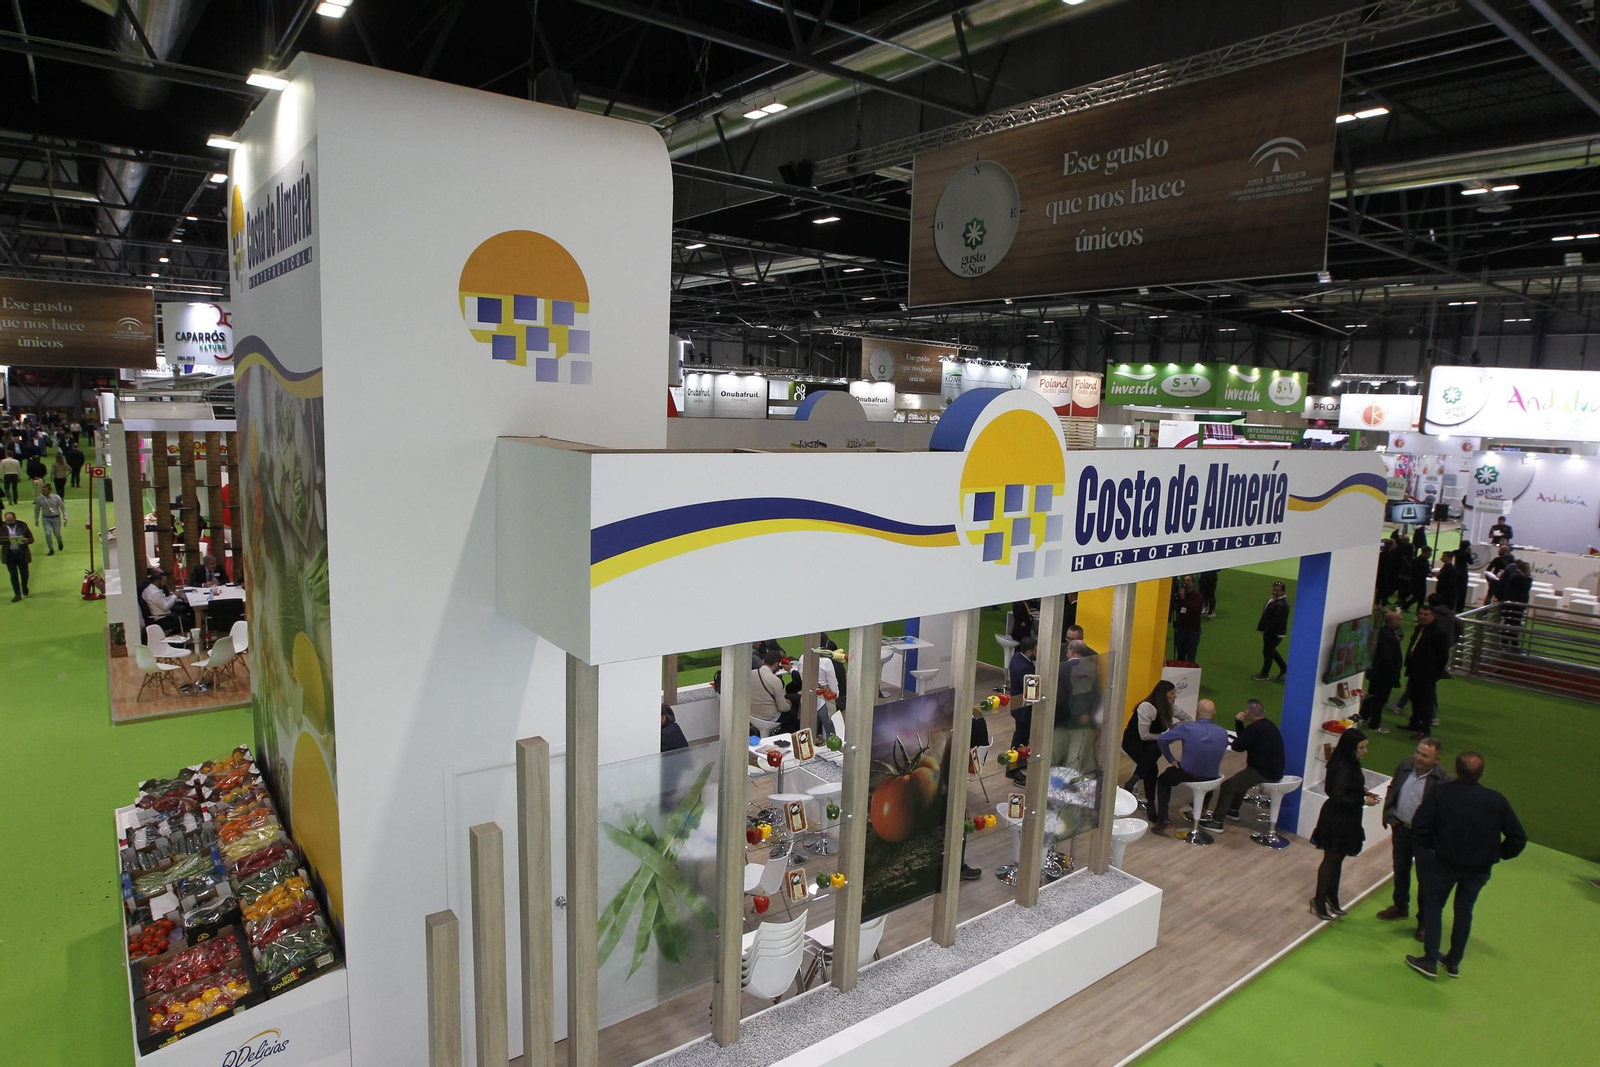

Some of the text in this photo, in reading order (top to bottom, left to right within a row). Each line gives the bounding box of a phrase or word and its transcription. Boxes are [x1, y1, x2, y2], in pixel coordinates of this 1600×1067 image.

[1062, 137, 1169, 176] Ese gusto
[973, 165, 981, 176] N
[1045, 178, 1186, 225] que nos hace
[247, 160, 312, 270] Costa de Almería
[1010, 208, 1017, 218] E
[937, 221, 944, 231] O
[1075, 226, 1144, 252] únicos
[961, 251, 986, 269] gusto
[969, 263, 986, 276] Sur
[2, 297, 73, 314] Ese gusto
[24, 322, 49, 330] nos
[52, 319, 85, 332] hace
[175, 329, 226, 342] CAPARRÓS
[18, 336, 64, 349] únicos
[1039, 378, 1068, 389] Poland
[1075, 379, 1097, 390] Poland
[1110, 382, 1157, 395] inverdu
[1225, 384, 1259, 402] inverdu
[1258, 433, 1285, 441] VERDURAS
[1075, 460, 1289, 546] Costa de Almería
[1072, 532, 1281, 571] HORTOFRUTICOLA
